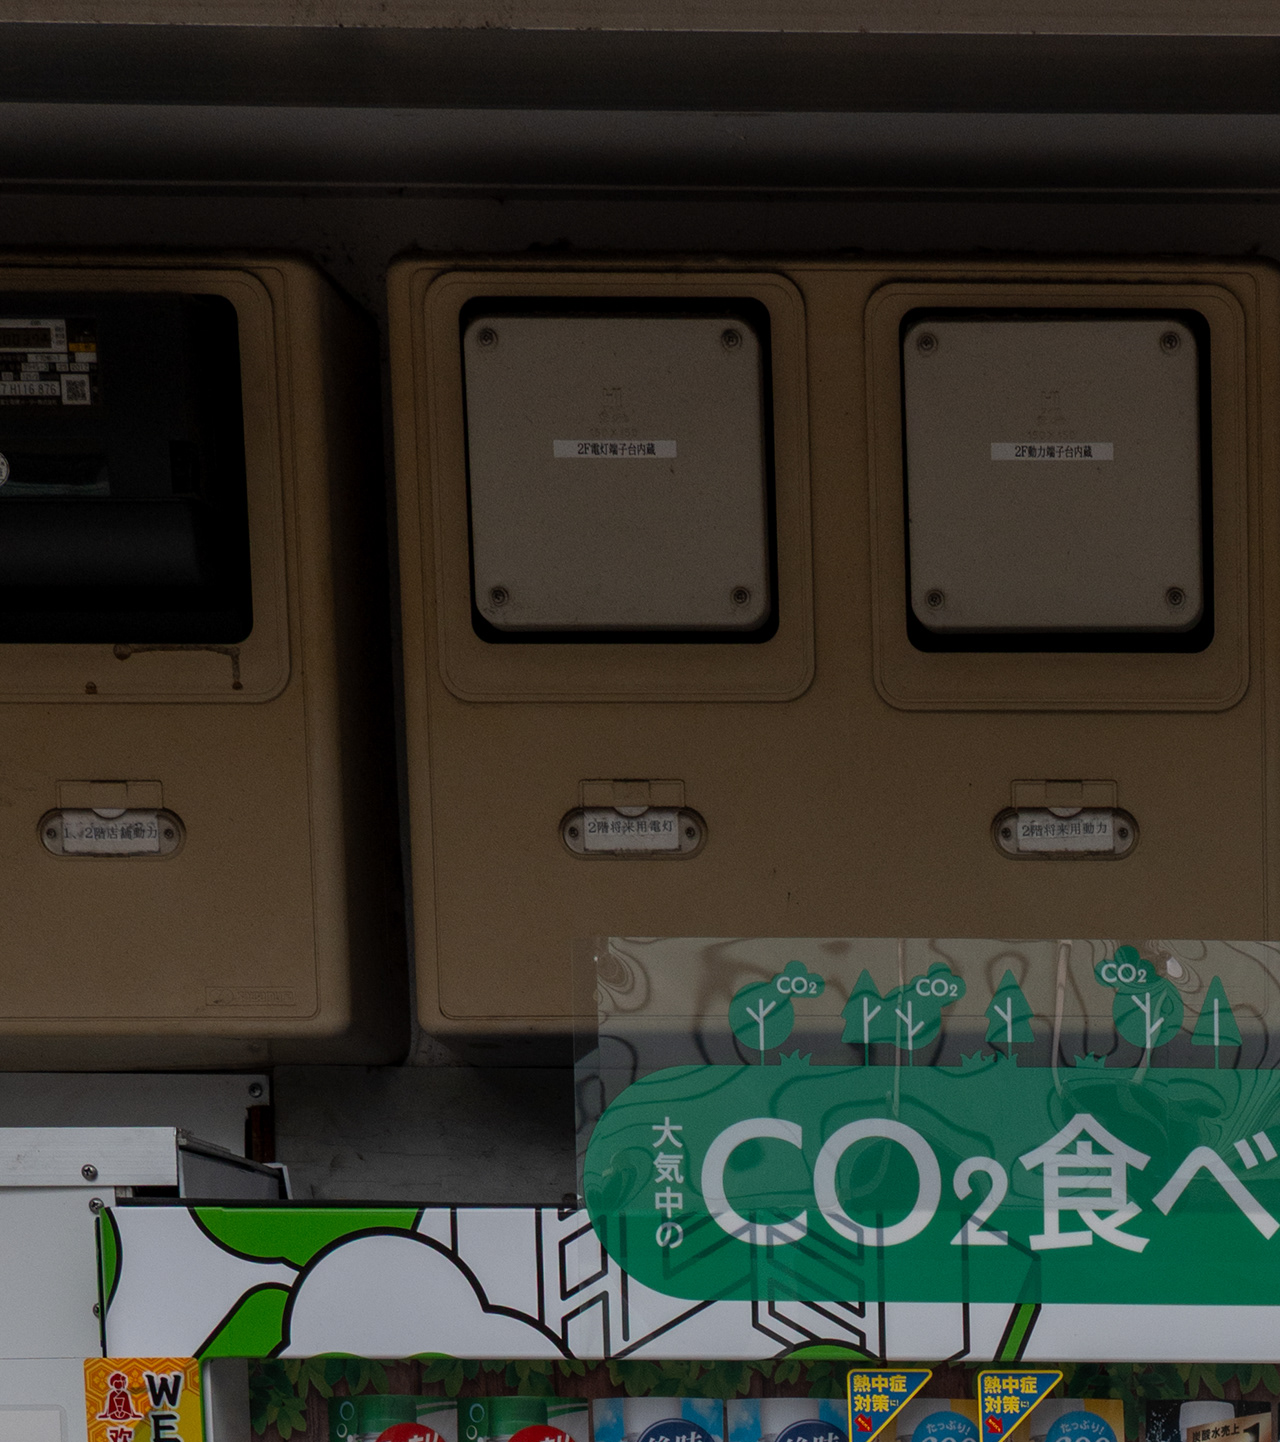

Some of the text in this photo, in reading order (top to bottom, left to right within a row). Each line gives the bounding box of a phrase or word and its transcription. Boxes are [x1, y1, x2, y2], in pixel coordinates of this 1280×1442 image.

[38, 383, 57, 395] 876
[577, 442, 657, 456] 2F電灯端子台内蔵
[1014, 445, 1093, 459] 2F動力端子台内蔵
[588, 820, 673, 834] 2階将来用電灯
[1021, 822, 1108, 838] 2階将来用動力
[775, 975, 818, 996] CO2
[915, 977, 959, 998] CO2
[650, 1115, 685, 1248] 大気中の
[853, 1374, 907, 1393] 熱中症
